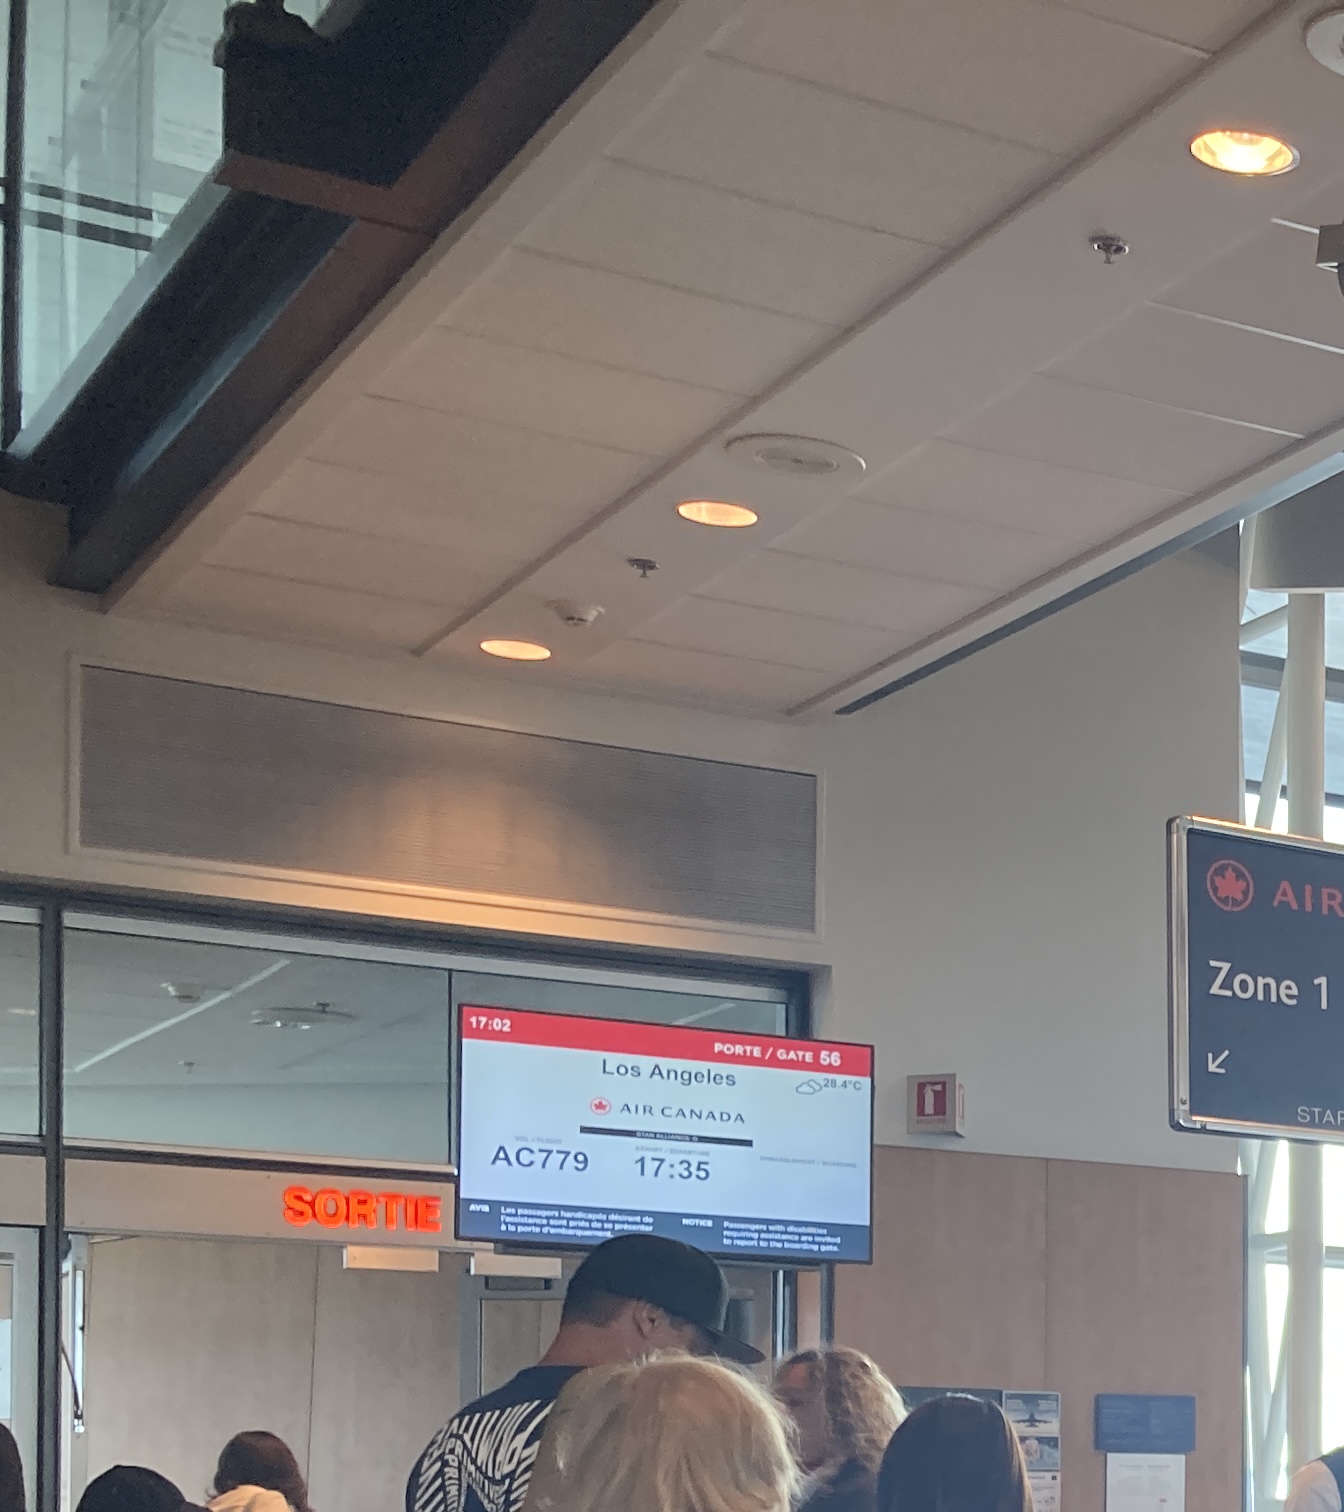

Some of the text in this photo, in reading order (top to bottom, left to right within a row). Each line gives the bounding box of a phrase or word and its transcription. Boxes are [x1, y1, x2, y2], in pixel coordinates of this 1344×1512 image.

[1208, 959, 1328, 1010] Zone 1
[468, 1016, 512, 1033] 17:02
[713, 1042, 842, 1067] PORTE / GATE 56
[602, 1058, 737, 1087] Los Angeles
[823, 1078, 863, 1091] 28.4°C
[620, 1103, 745, 1124] AIR CANADA
[490, 1145, 589, 1172] AC779
[634, 1156, 710, 1181] 17:35
[283, 1185, 443, 1233] SORTIE
[517, 1207, 559, 1218] passagers
[517, 1225, 540, 1235] porte
[549, 1217, 567, 1226] sont
[681, 1218, 713, 1227] NOTICE
[723, 1221, 767, 1232] Passengers
[768, 1223, 785, 1232] with
